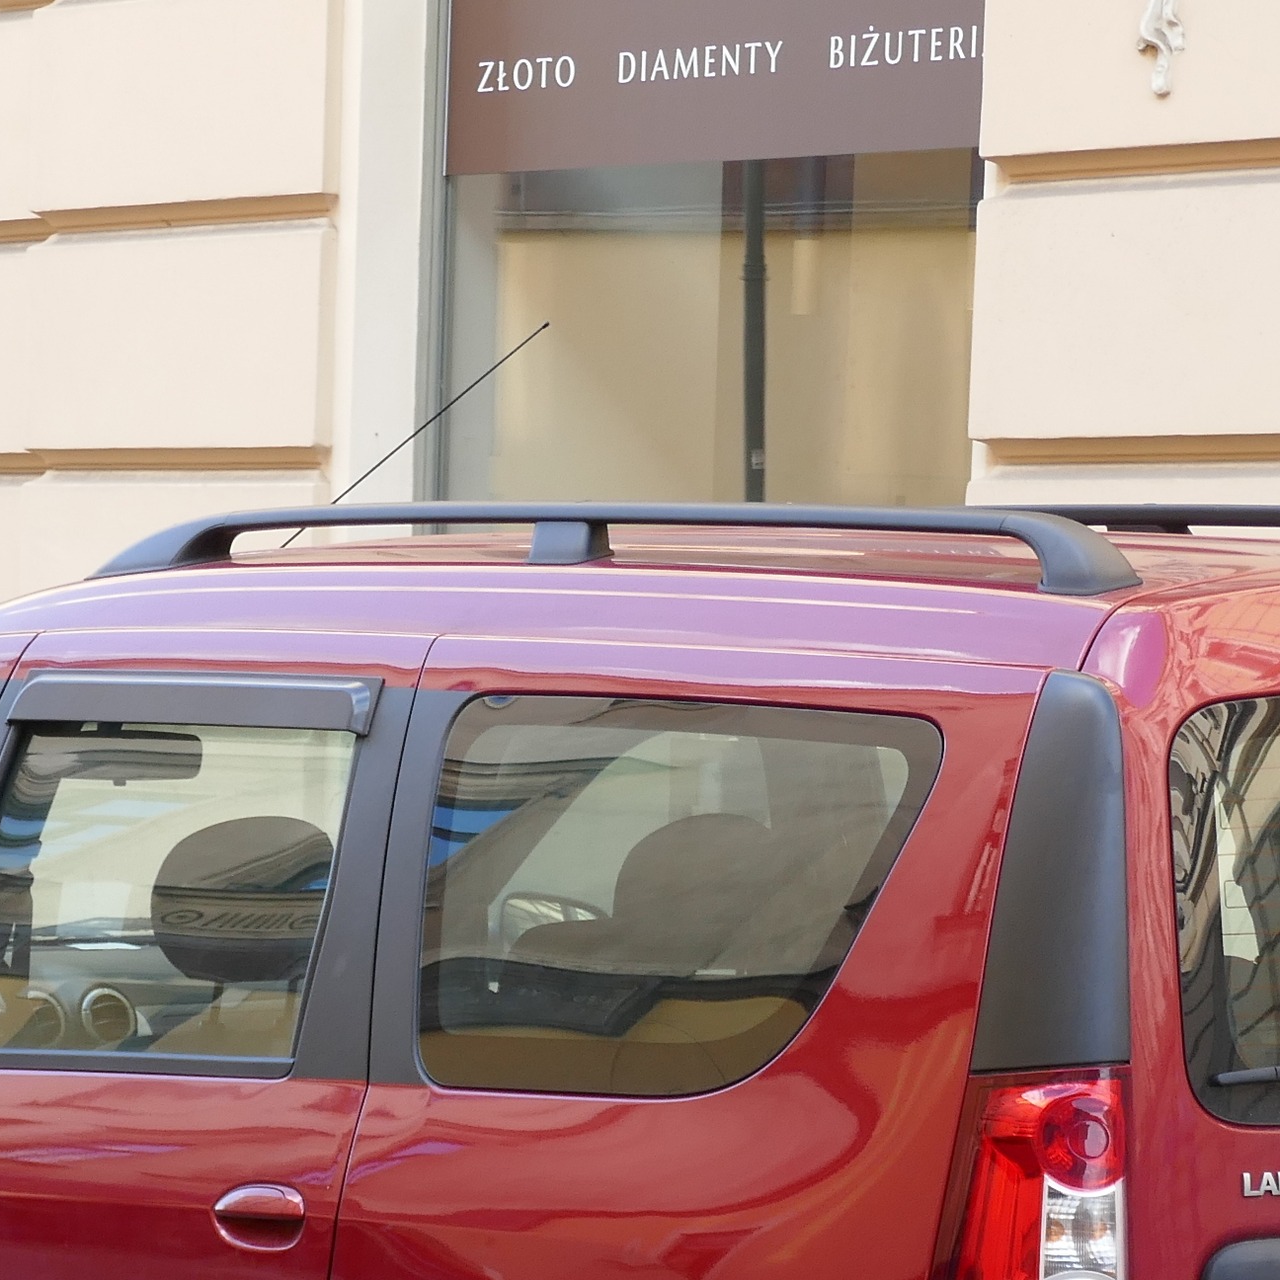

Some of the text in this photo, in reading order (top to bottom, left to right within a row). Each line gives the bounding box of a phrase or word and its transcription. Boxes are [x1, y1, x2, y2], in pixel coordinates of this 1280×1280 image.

[477, 25, 984, 92] ZŁOTO DIAMENTY BIŻUTERI
